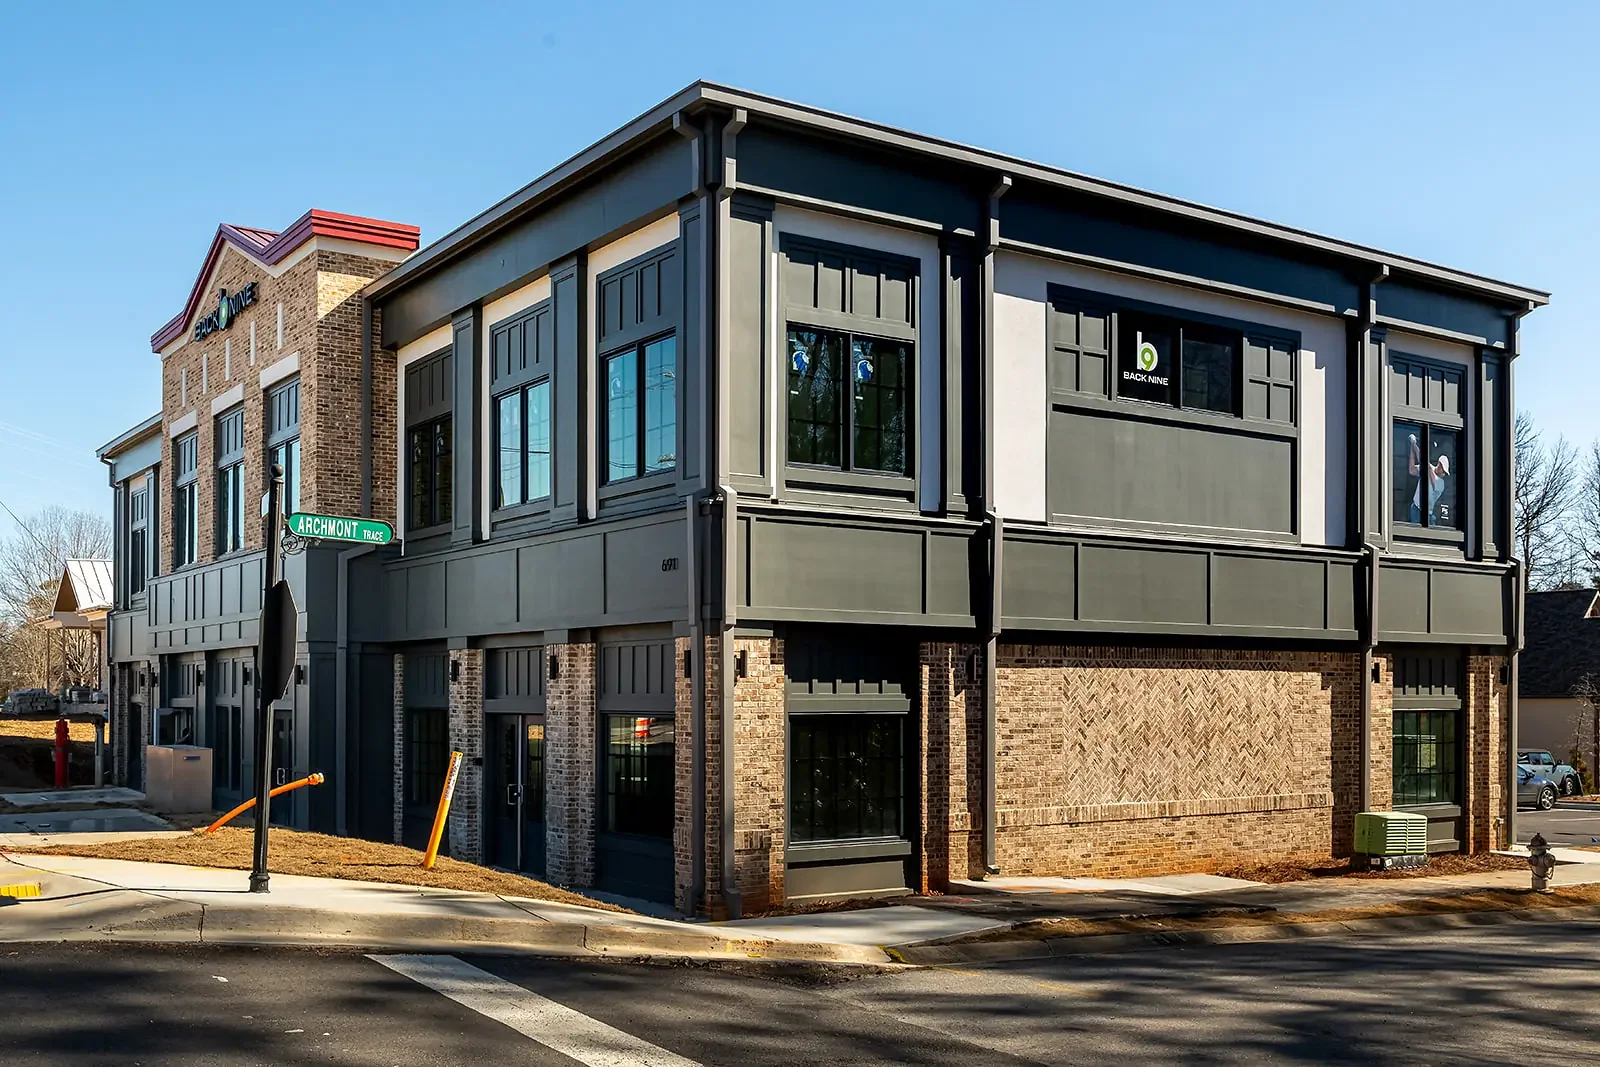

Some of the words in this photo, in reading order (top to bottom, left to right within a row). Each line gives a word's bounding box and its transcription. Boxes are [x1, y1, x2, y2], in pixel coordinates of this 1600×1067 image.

[195, 308, 220, 341] BACK
[228, 281, 258, 318] NINE
[1123, 371, 1147, 382] BACK
[1148, 375, 1169, 385] NINE
[297, 517, 358, 538] ARCHMONT
[363, 529, 384, 541] TRACE
